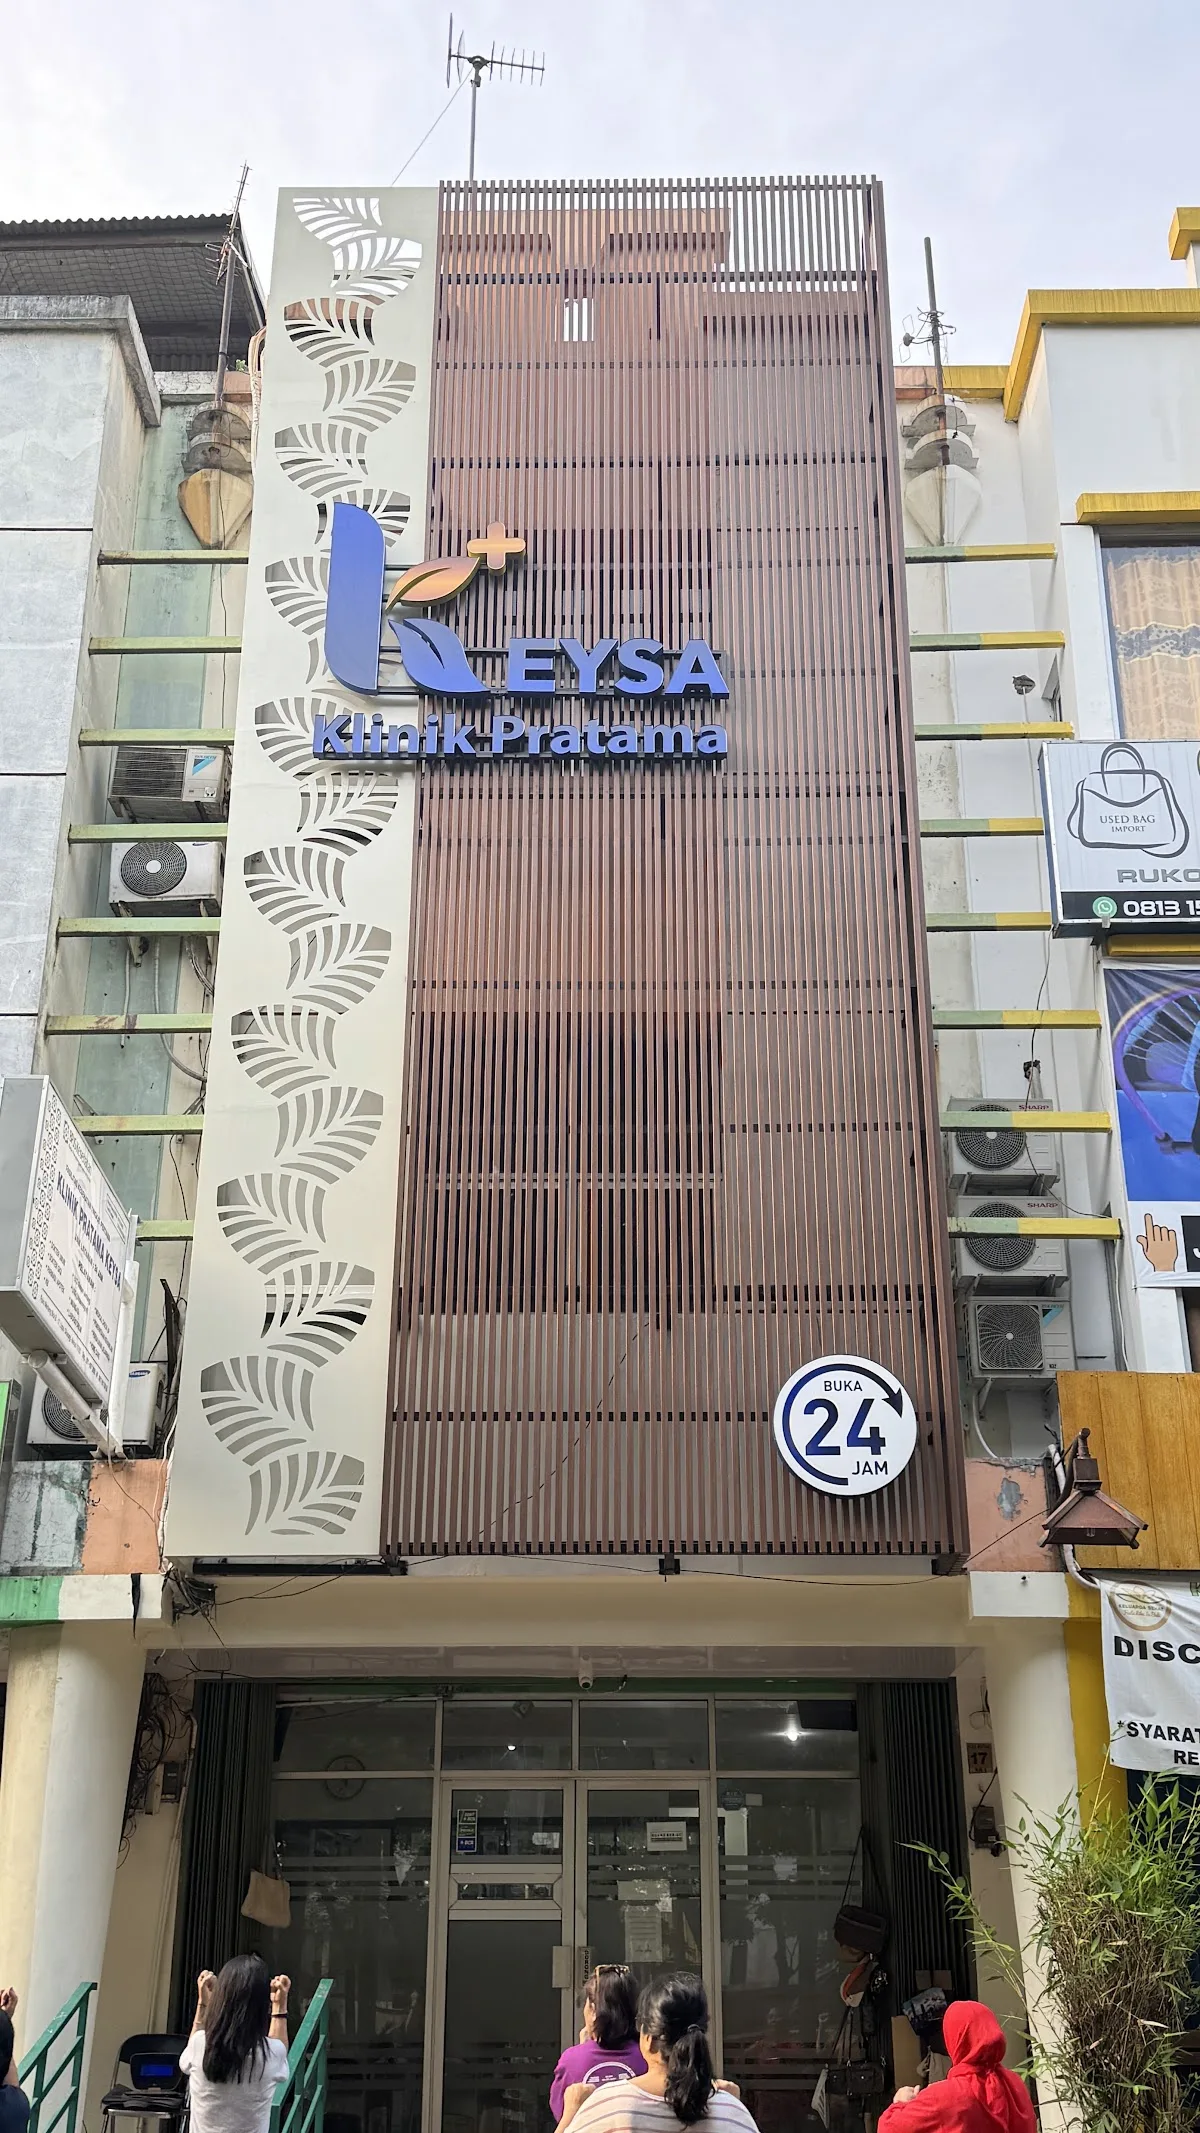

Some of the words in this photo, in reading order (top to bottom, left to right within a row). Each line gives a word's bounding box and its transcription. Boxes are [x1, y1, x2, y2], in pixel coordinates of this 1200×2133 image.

[313, 713, 476, 759] Klinik
[493, 715, 728, 759] Pratama
[1100, 815, 1130, 824] USED
[1133, 814, 1156, 824] BAG
[1117, 869, 1200, 883] RUKO
[1124, 900, 1180, 916] 0813
[56, 1169, 78, 1220] KLINIK
[78, 1205, 104, 1263] PRATAMA
[104, 1248, 121, 1291] KEYSA
[824, 1380, 863, 1392] BUKA
[804, 1398, 886, 1456] 24
[852, 1460, 888, 1476] JAM
[1114, 1635, 1200, 1664] DISC
[971, 1752, 988, 1764] 17
[1174, 1750, 1200, 1766] RE
